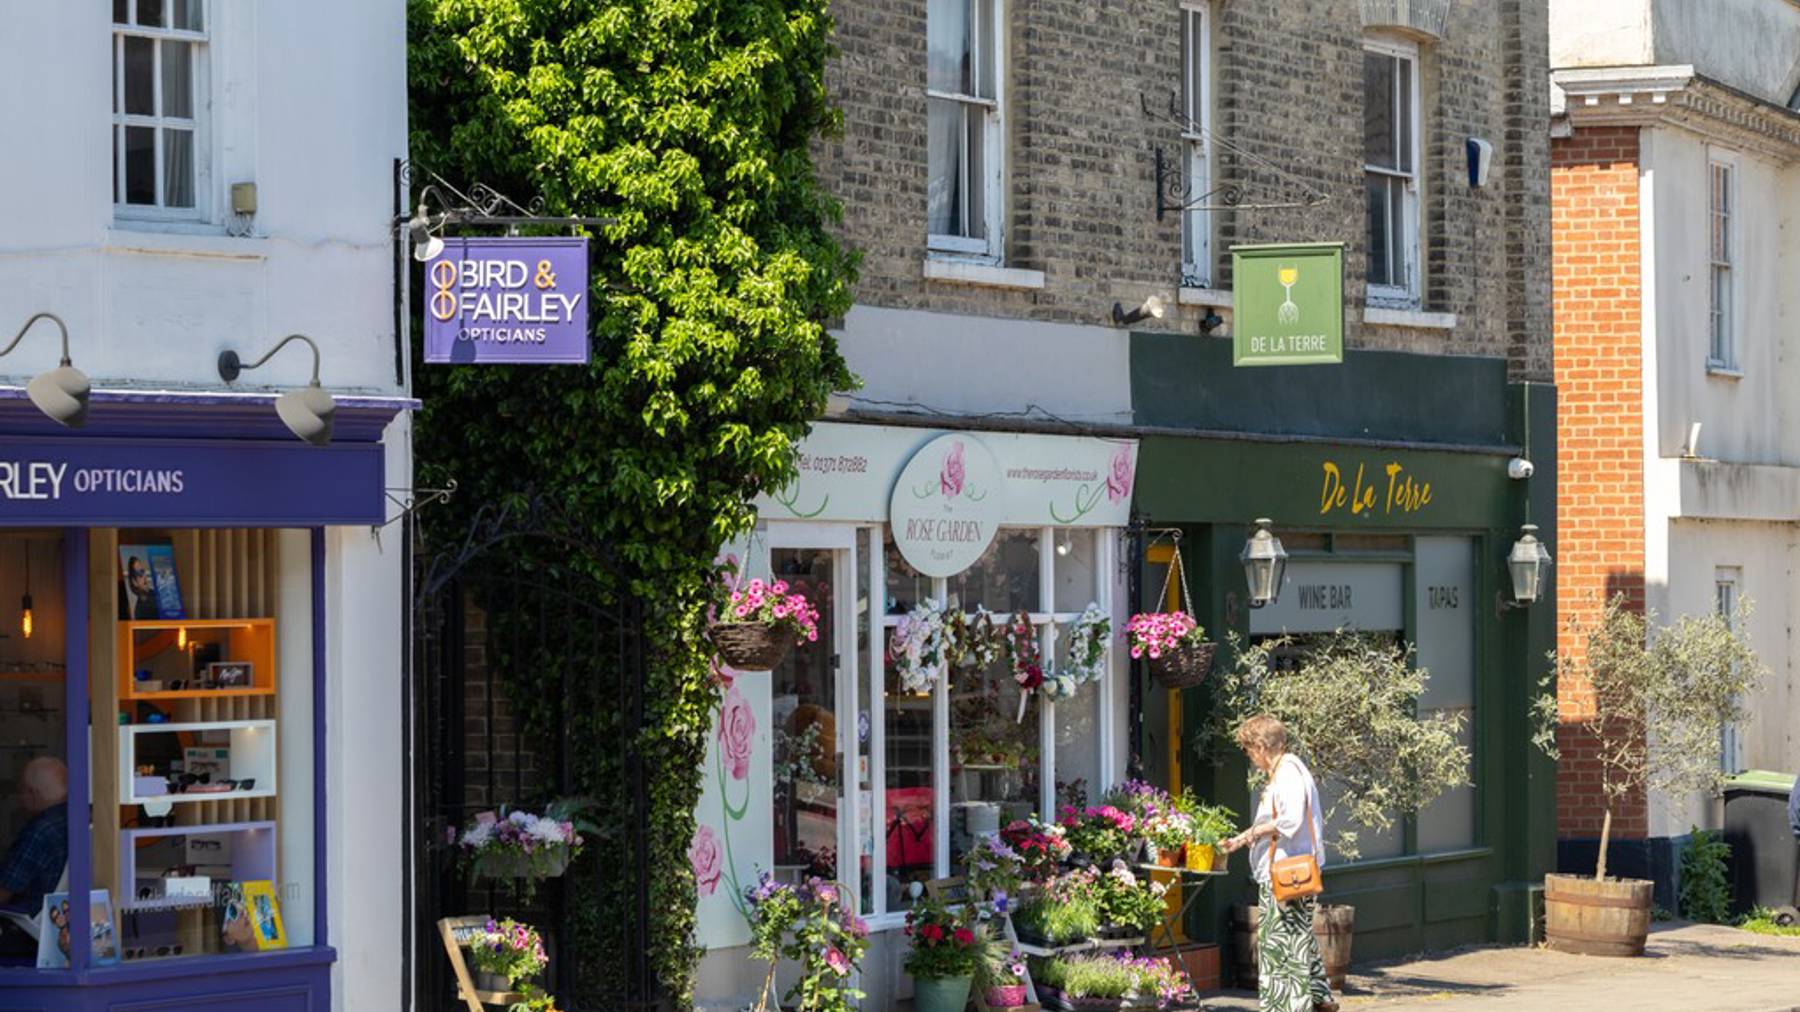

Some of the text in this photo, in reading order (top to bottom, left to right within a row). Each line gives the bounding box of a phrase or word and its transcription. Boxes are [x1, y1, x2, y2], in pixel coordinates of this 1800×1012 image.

[458, 259, 557, 289] BIRD &
[458, 293, 581, 322] FAIRLEY
[458, 327, 546, 343] OPTICIANS
[1251, 334, 1327, 352] DE LA TERRE
[73, 469, 184, 493] OPTICIANS
[1320, 461, 1433, 514] De La Terre
[905, 517, 983, 542] ROSE GARDEN
[1298, 584, 1353, 610] WINE BAR
[1428, 586, 1459, 609] TAPAS
